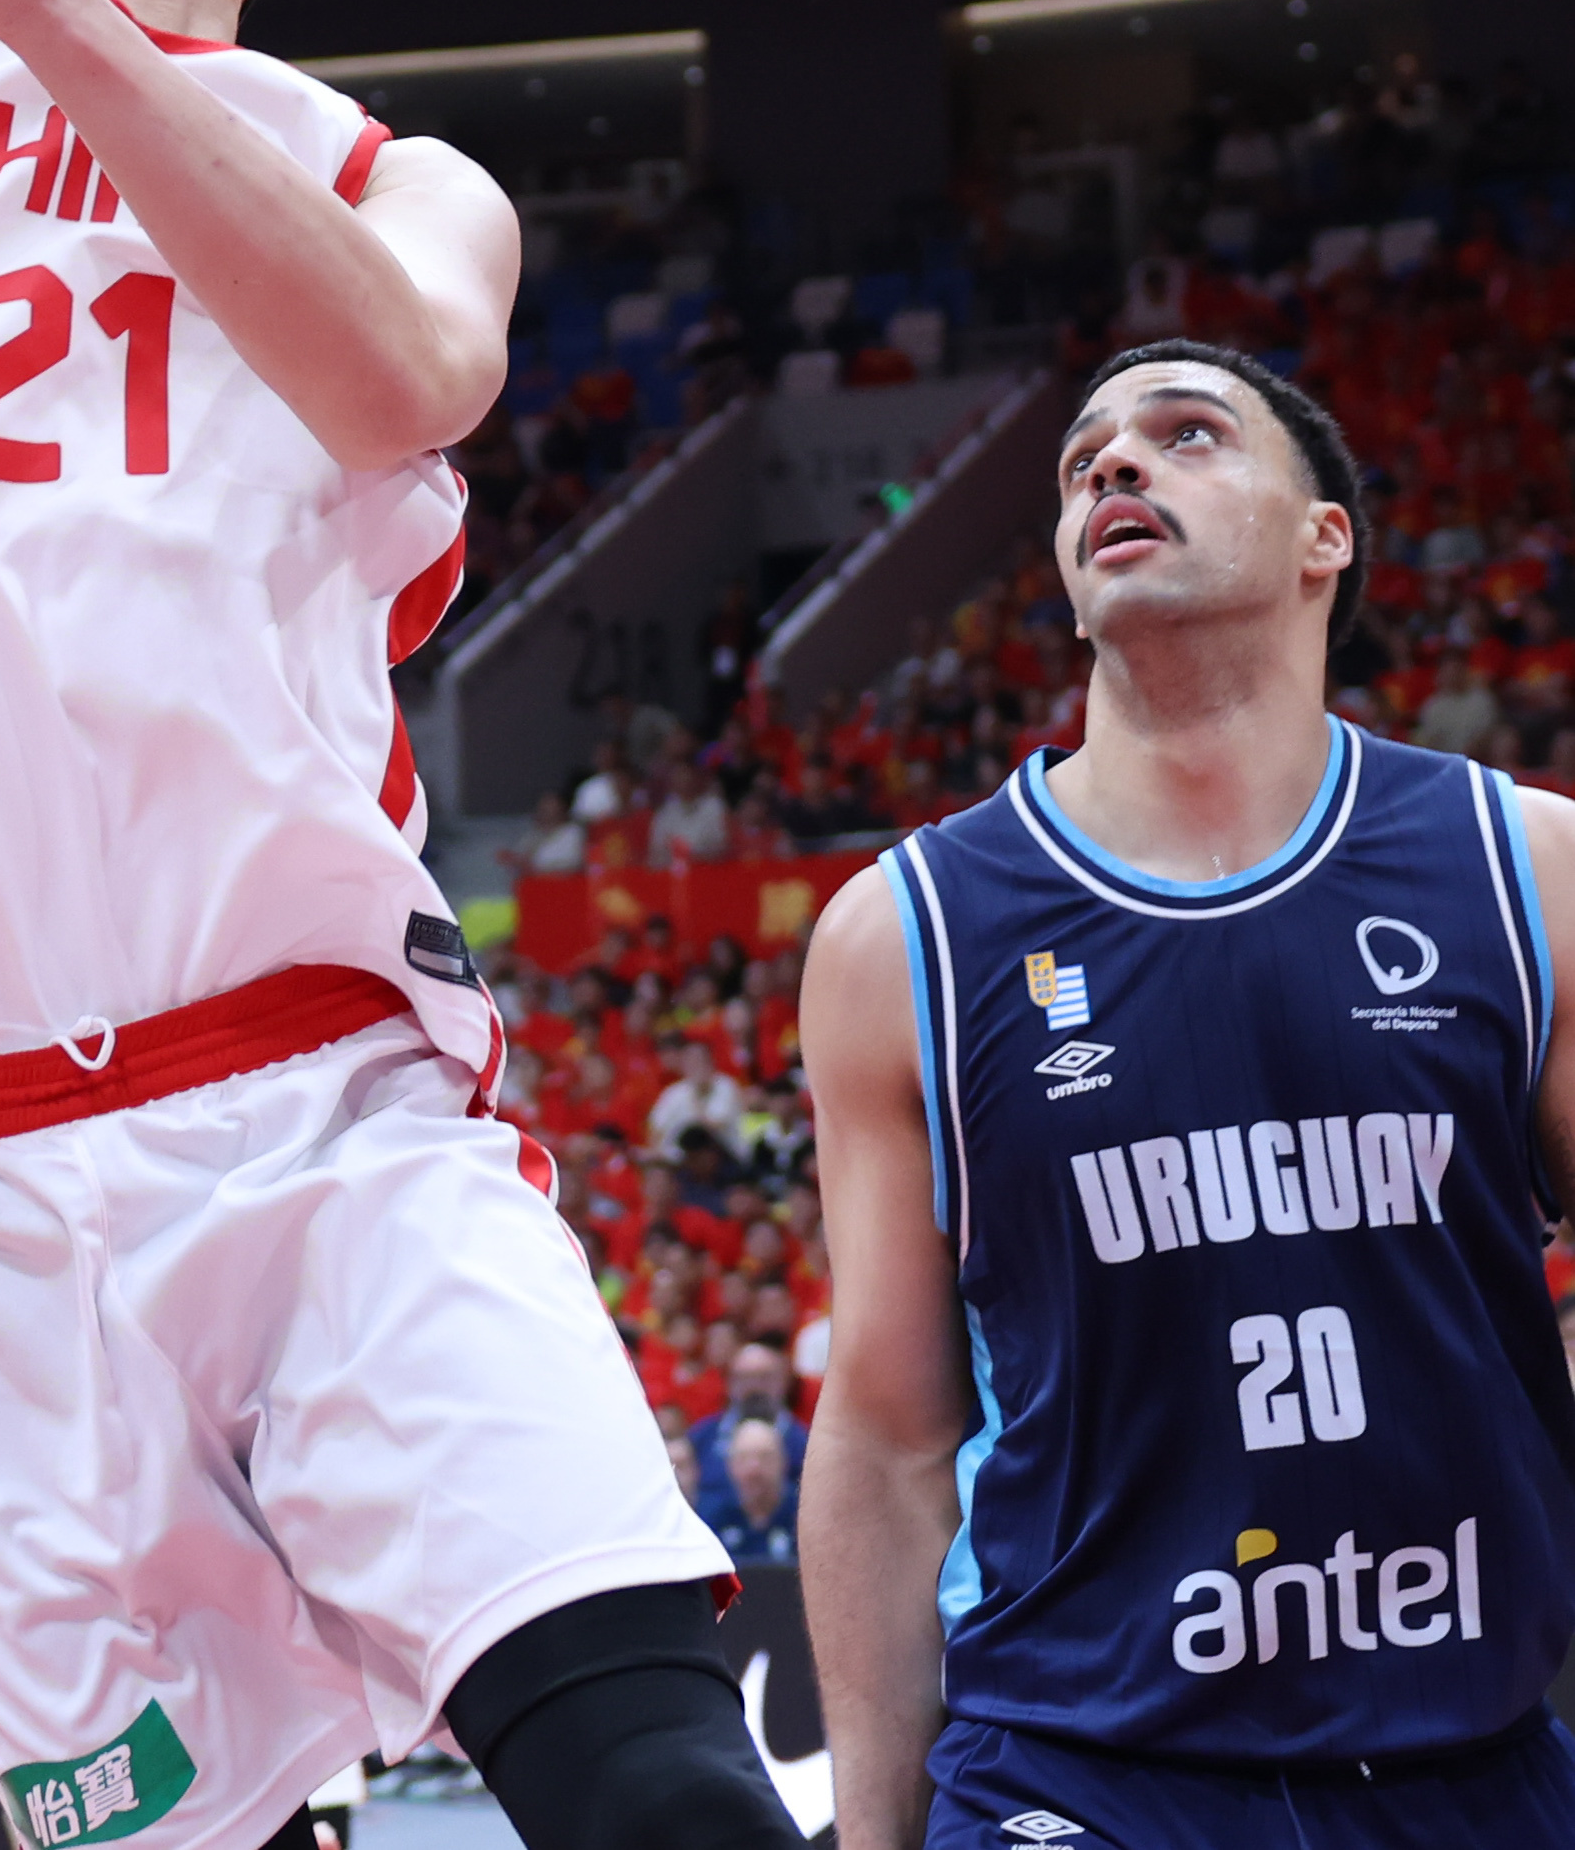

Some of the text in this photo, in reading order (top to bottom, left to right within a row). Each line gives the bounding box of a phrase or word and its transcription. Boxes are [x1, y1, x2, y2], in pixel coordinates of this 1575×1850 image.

[1045, 1072, 1113, 1101] umbro
[1070, 1112, 1454, 1265] URUGUAY
[1229, 1305, 1367, 1452] 20
[1172, 1516, 1483, 1674] antel
